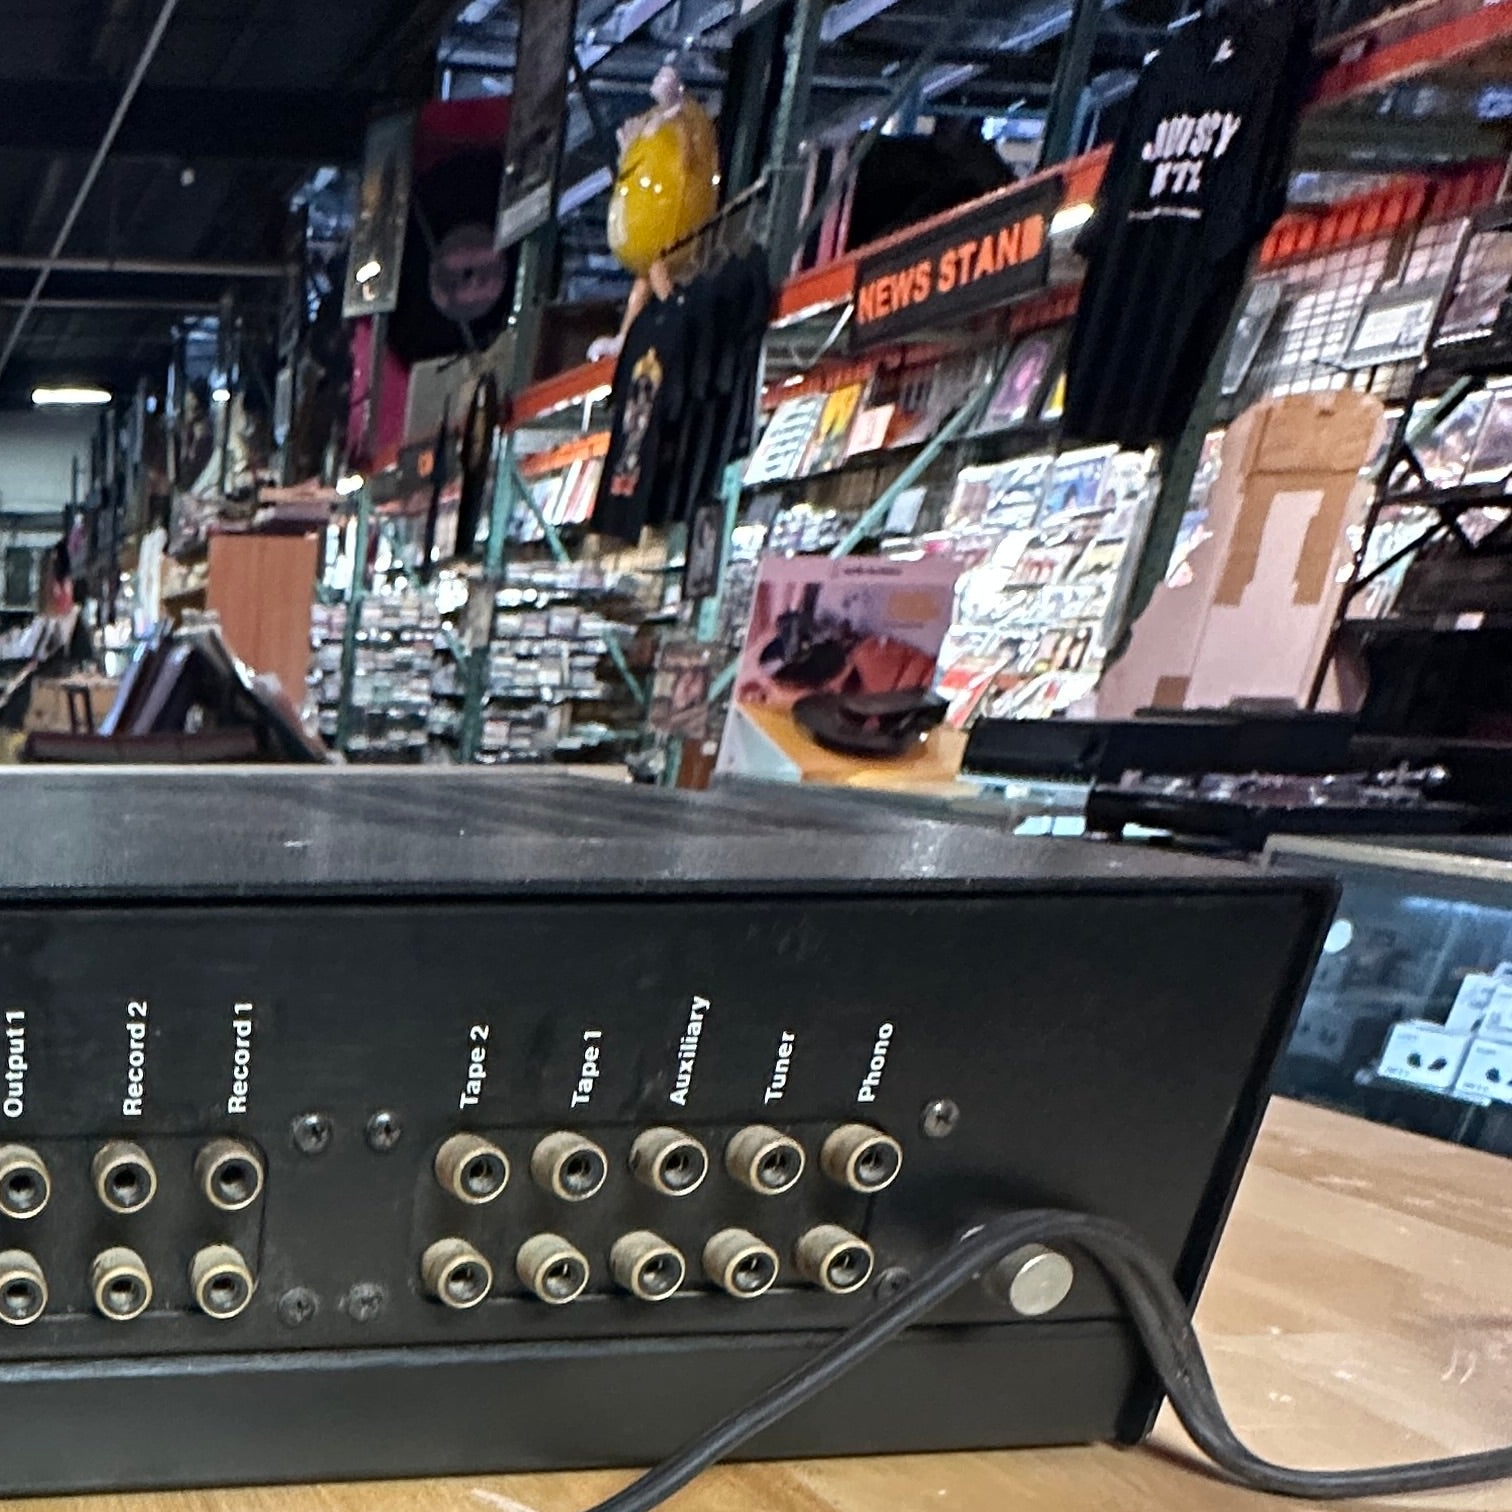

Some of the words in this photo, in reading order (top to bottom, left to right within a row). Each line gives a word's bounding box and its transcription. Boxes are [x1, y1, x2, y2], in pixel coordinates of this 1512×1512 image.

[857, 257, 932, 325] NEWS
[6, 1010, 25, 1023] 1
[127, 1001, 148, 1017] 2
[234, 1002, 253, 1015] 1
[469, 1024, 489, 1041] 2
[583, 1030, 602, 1042] 1
[3, 1027, 28, 1118] Output
[122, 1022, 146, 1116] Record
[227, 1020, 252, 1114] Record
[459, 1047, 487, 1110] Tape
[570, 1046, 600, 1109] Tape
[669, 995, 711, 1106] Auxiliary
[764, 1030, 796, 1105] Tuner
[857, 1022, 894, 1102] Phono
